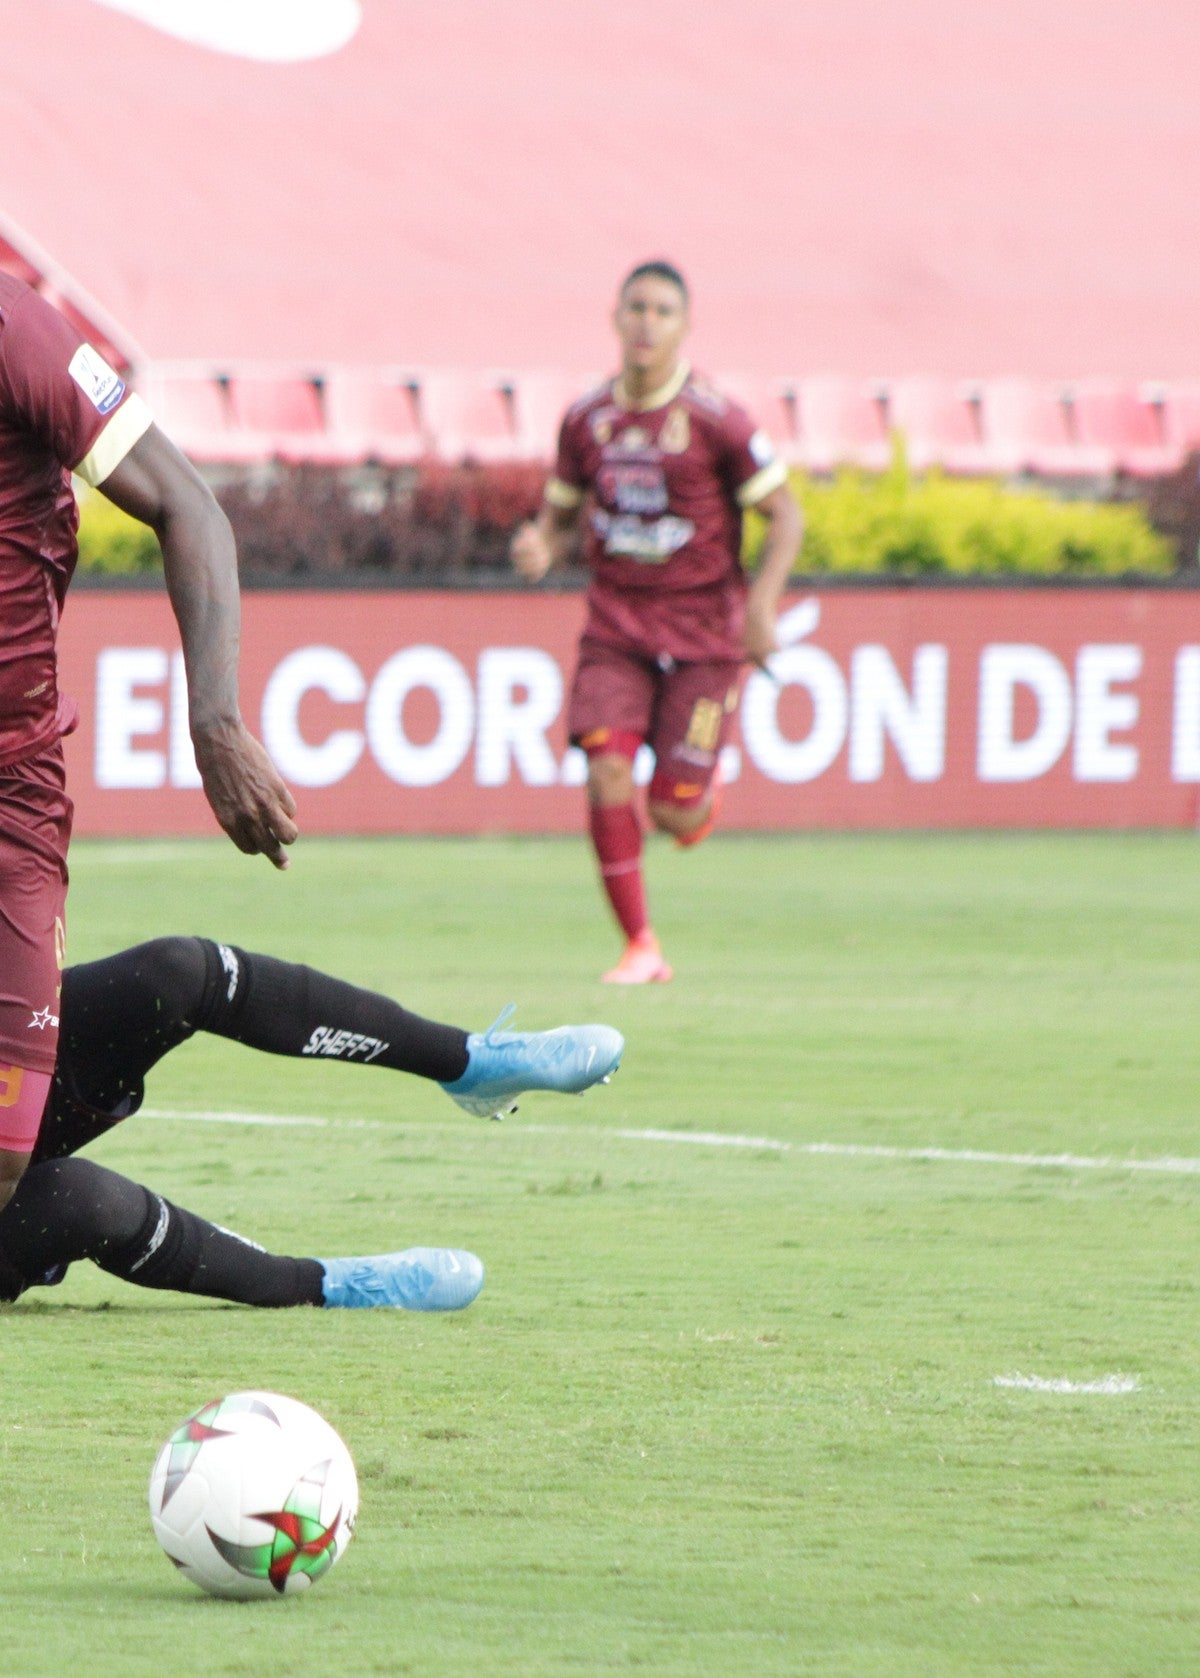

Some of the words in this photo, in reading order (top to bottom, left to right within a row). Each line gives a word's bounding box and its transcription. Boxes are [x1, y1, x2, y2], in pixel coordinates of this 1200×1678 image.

[261, 600, 946, 788] CORÓN
[974, 642, 1142, 784] DE
[302, 1025, 390, 1063] SHEFFY
